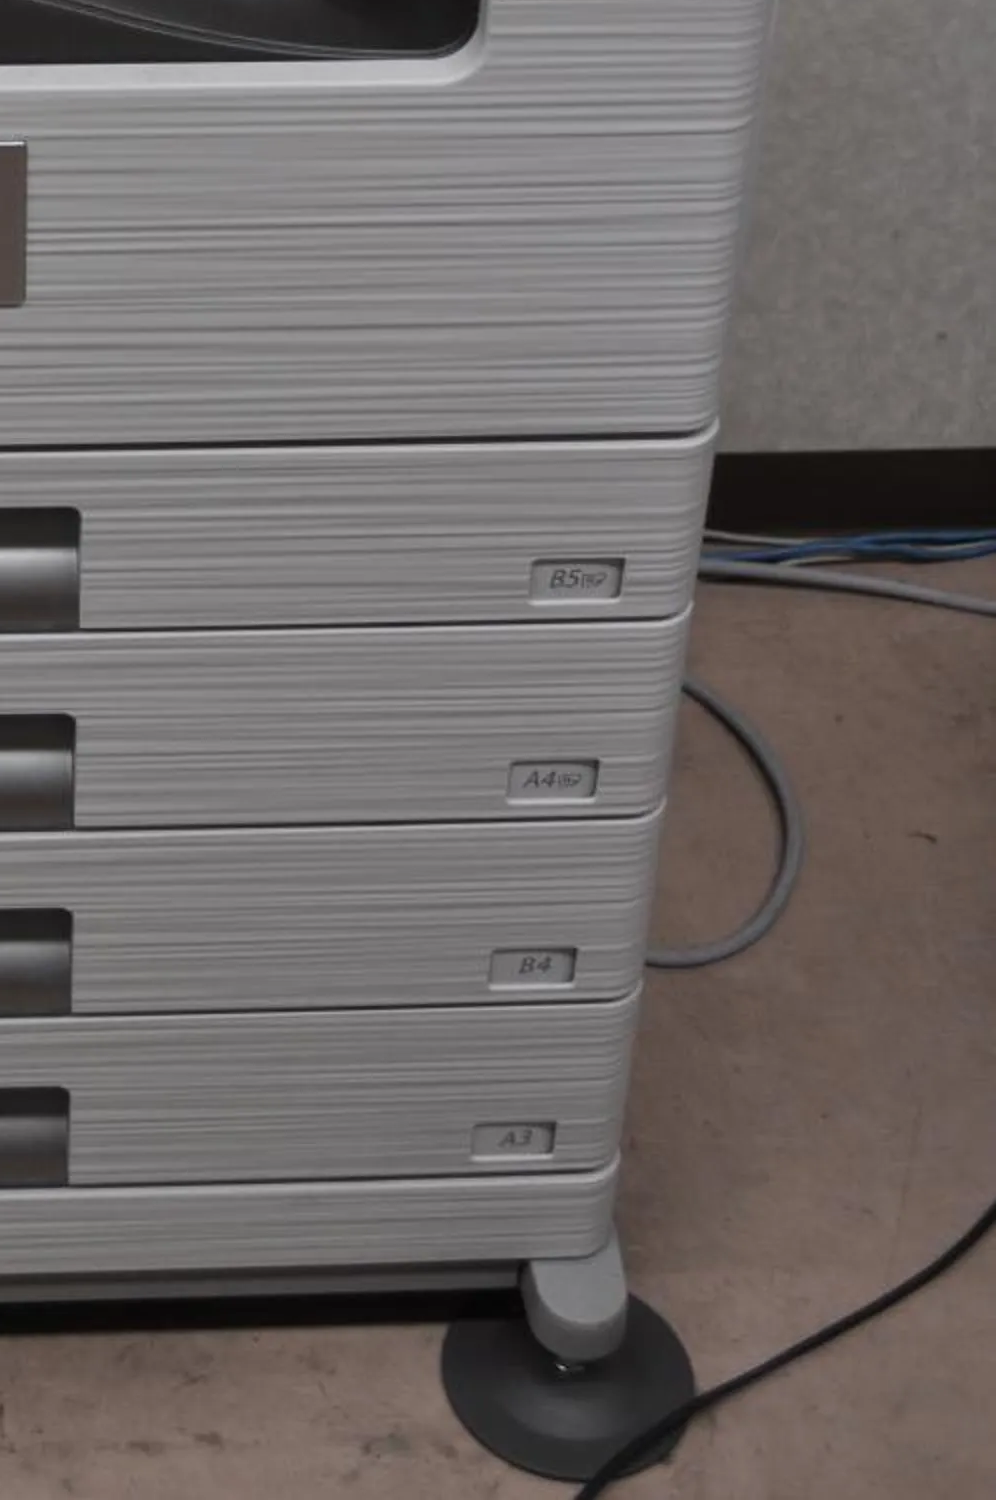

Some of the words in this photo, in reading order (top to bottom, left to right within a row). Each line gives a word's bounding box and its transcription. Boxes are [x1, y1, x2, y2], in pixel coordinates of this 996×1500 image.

[549, 568, 583, 590] B5
[521, 768, 557, 789] A4
[518, 955, 553, 975] B4
[498, 1128, 534, 1149] A3
